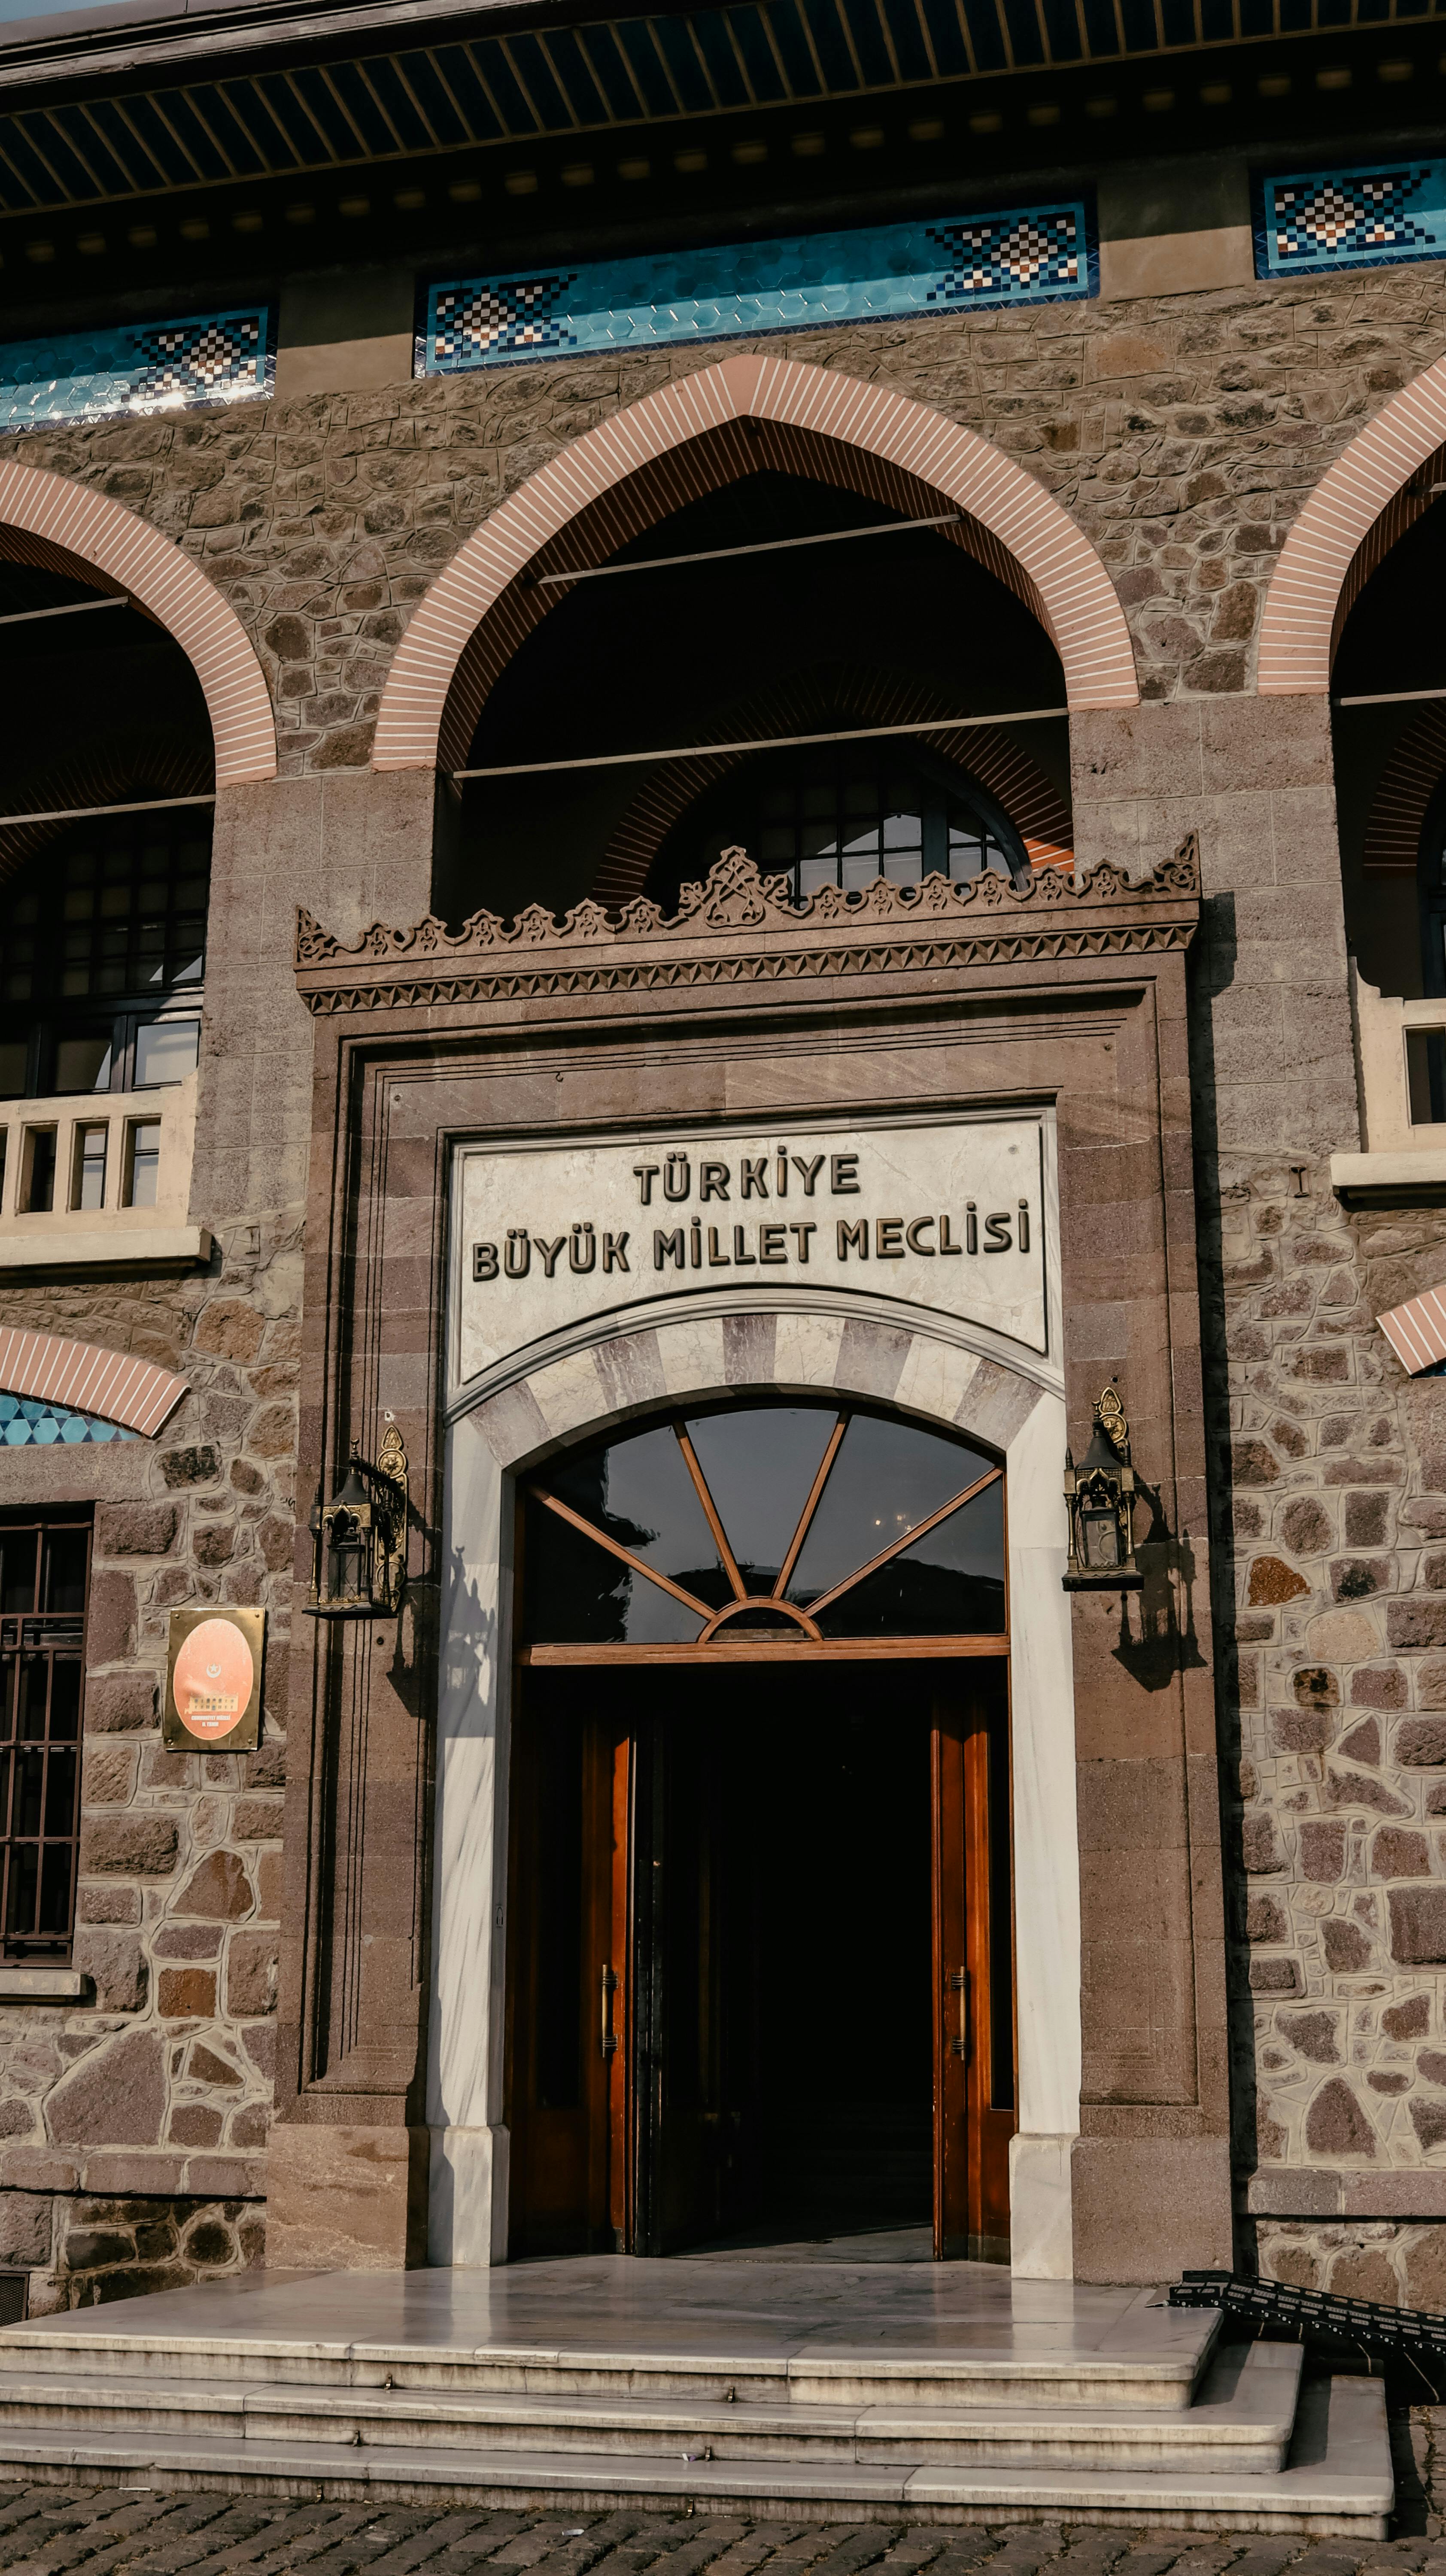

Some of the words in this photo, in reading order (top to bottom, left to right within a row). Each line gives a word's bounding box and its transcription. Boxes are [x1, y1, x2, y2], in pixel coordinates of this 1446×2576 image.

[633, 1145, 859, 1205] TÜRKİYE
[472, 1223, 631, 1282] BÜYÜK
[653, 1216, 817, 1270] MİLLET
[836, 1198, 1030, 1260] MECLİSİ
